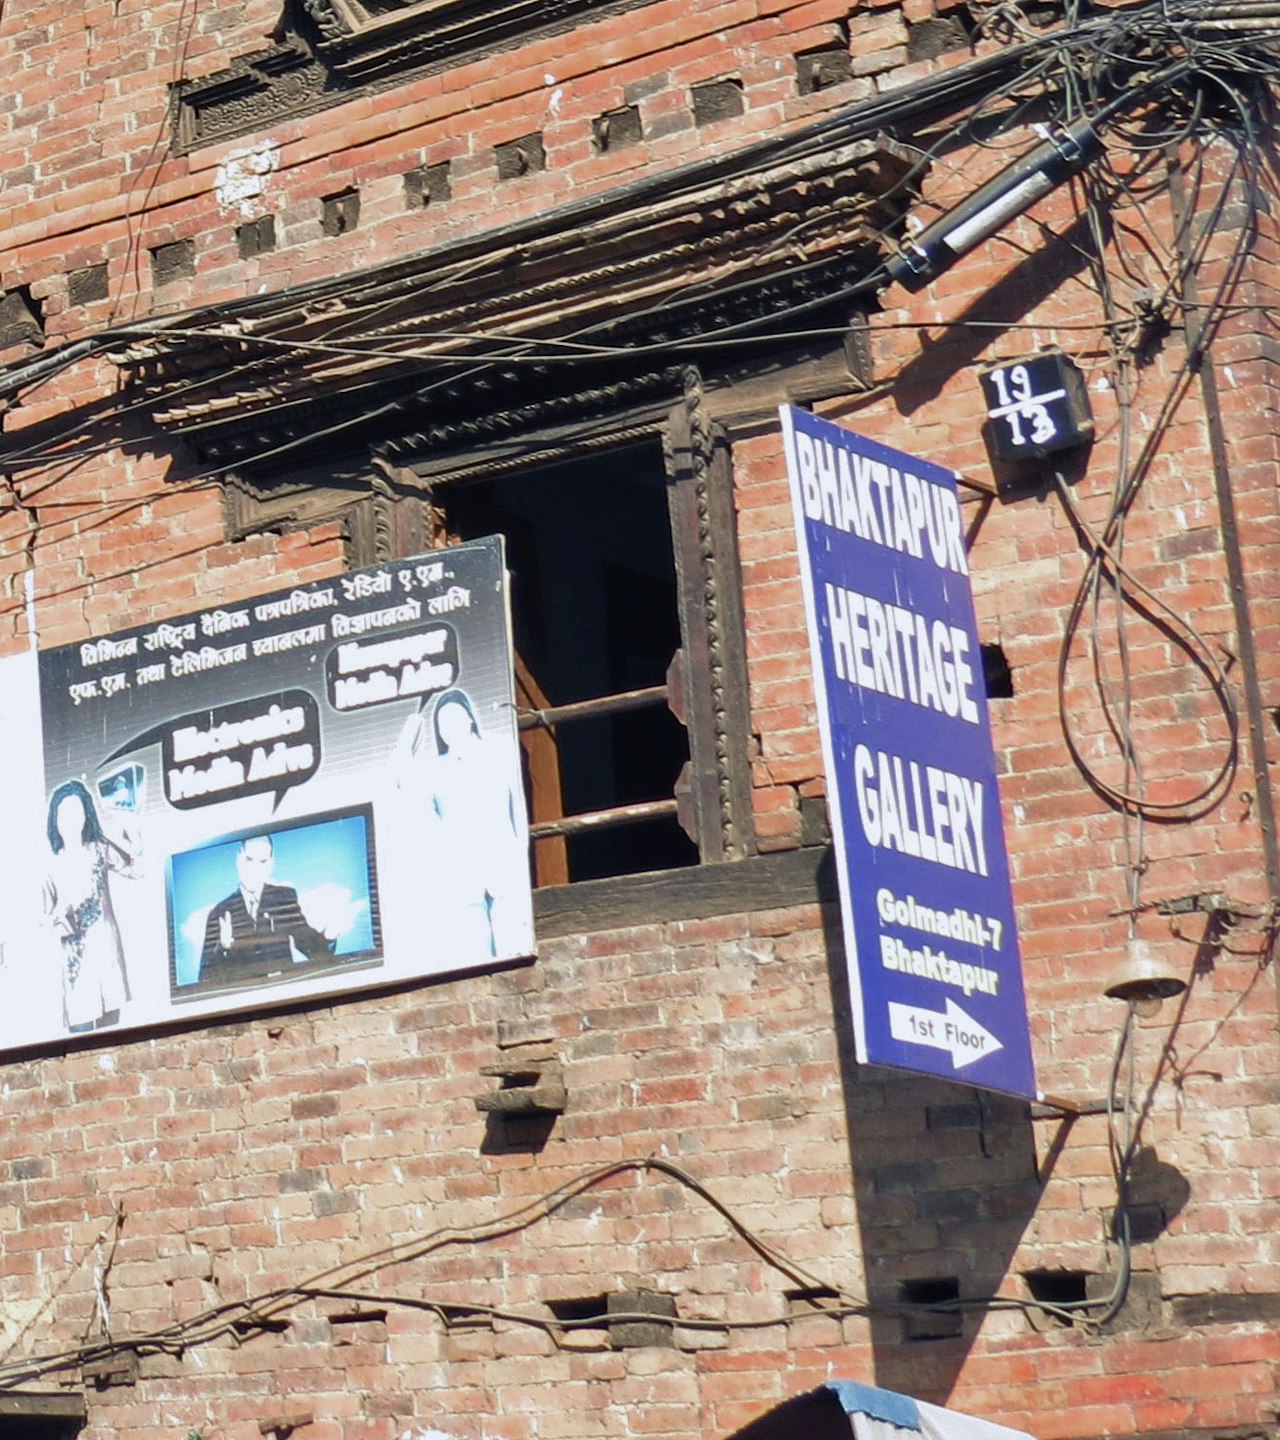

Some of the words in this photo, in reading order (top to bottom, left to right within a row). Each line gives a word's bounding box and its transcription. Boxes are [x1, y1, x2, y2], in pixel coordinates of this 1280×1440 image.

[990, 365, 1032, 406] 19
[795, 430, 969, 577] BHAKTAPUR
[136, 663, 166, 686] तथा
[427, 585, 471, 615] लागि
[200, 609, 251, 637] दैनिक
[825, 582, 980, 725] HERITAGE
[854, 743, 989, 877] GALLERY
[876, 887, 1003, 951] Golmadhi-7
[879, 934, 999, 997] Bhaktapur
[909, 1014, 935, 1038] 1st
[945, 1022, 986, 1052] Floor
